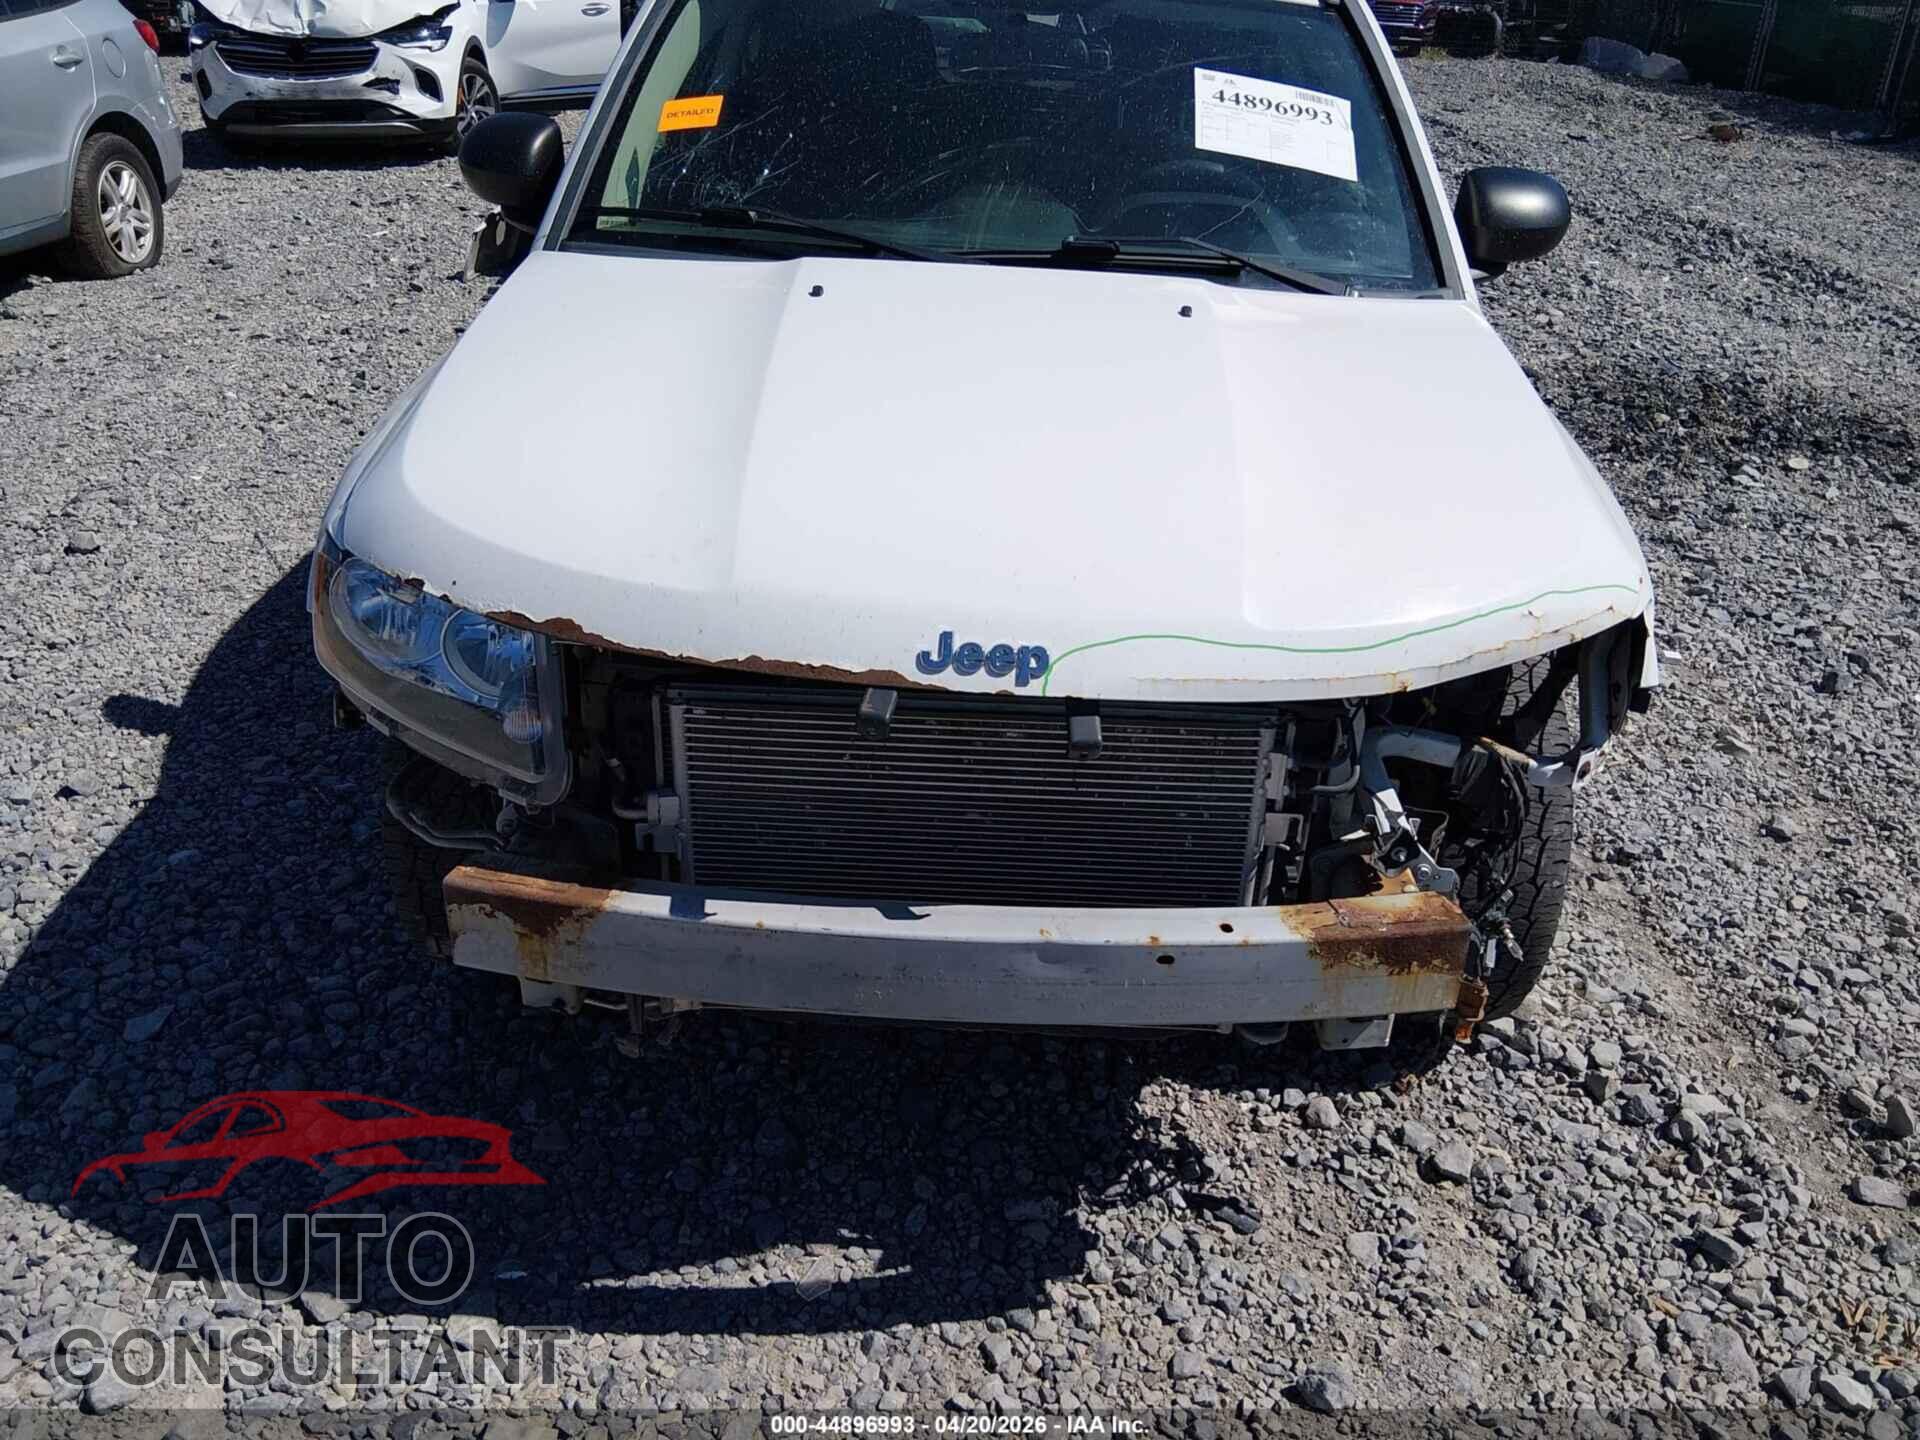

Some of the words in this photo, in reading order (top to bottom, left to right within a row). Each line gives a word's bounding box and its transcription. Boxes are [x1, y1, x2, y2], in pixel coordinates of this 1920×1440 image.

[667, 108, 714, 118] DETAILED
[1212, 89, 1334, 126] 44896993
[916, 631, 1050, 688] Jeep
